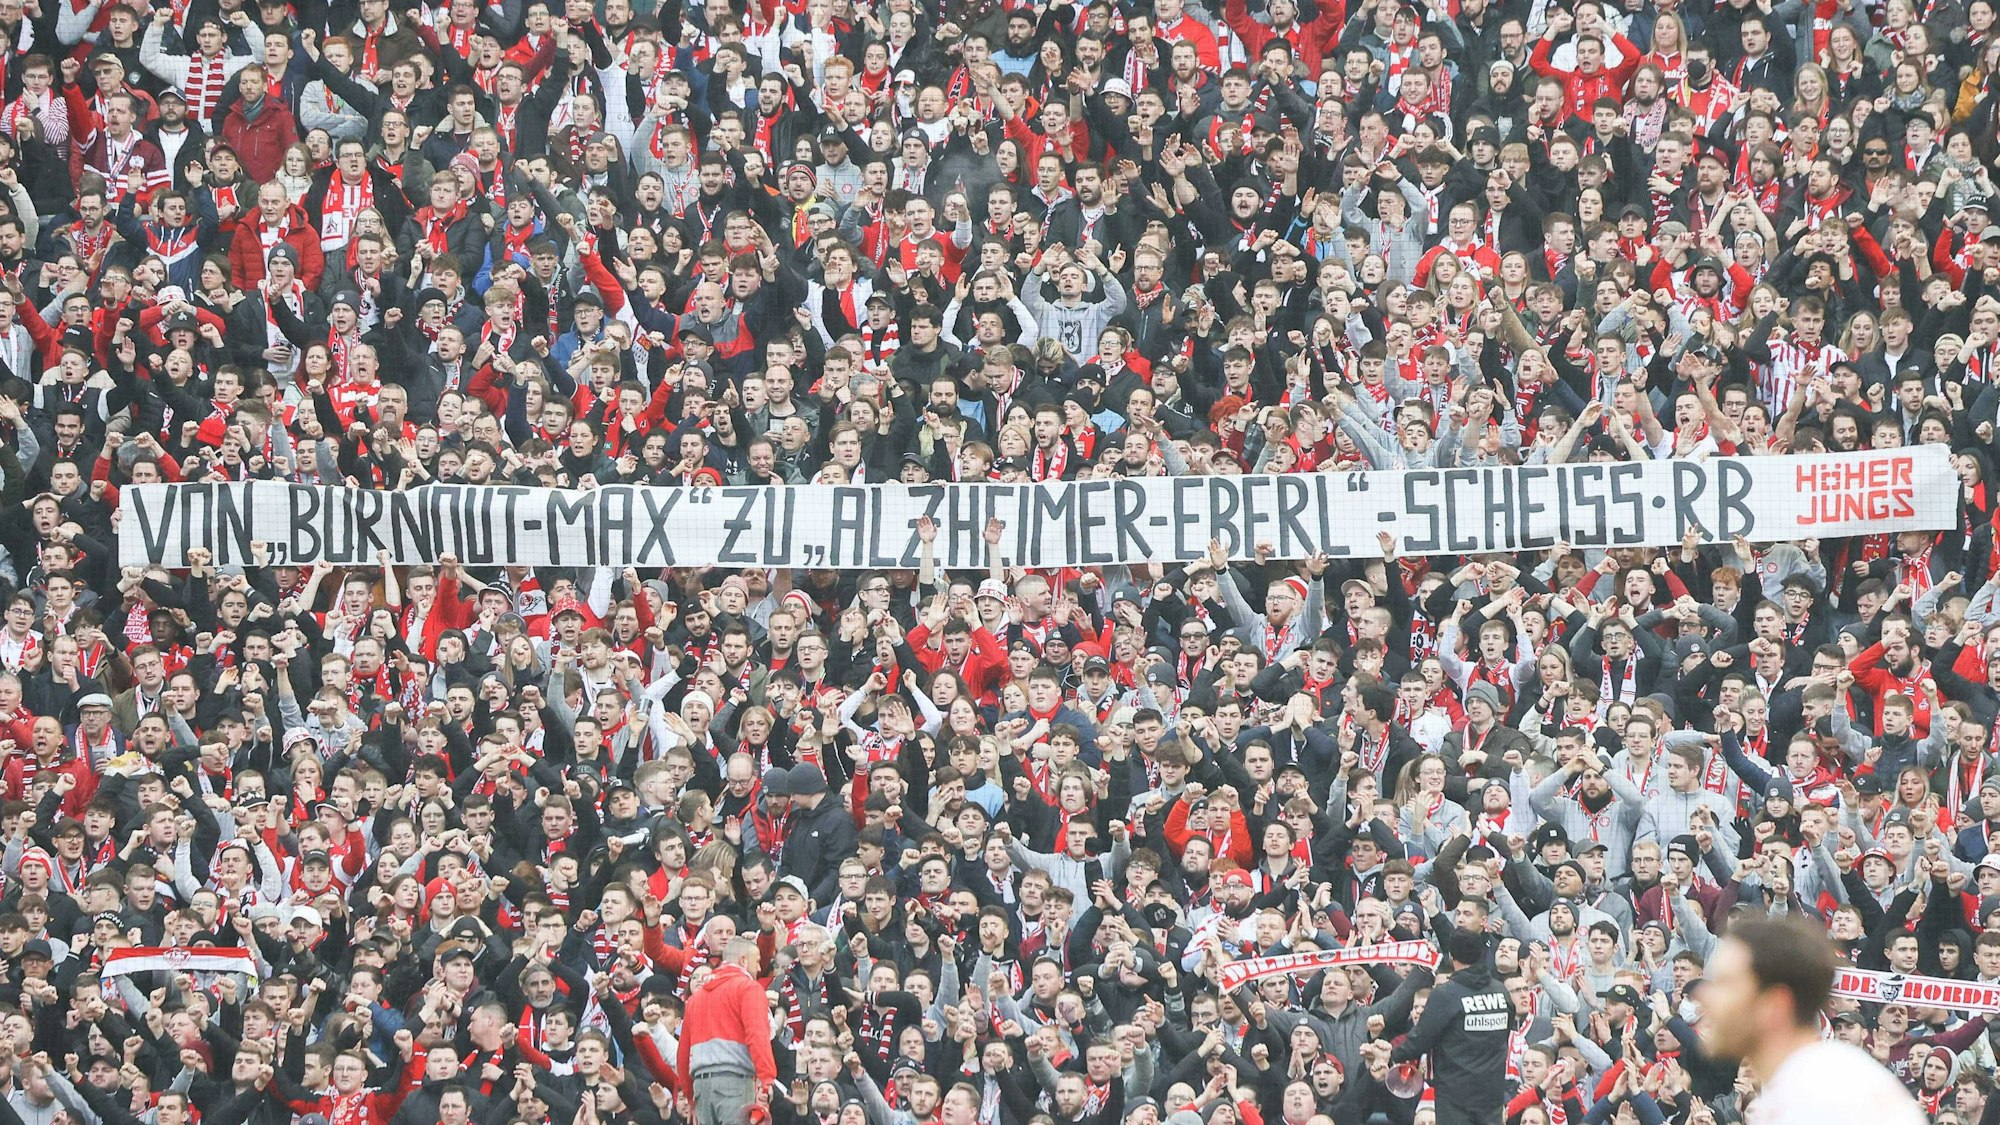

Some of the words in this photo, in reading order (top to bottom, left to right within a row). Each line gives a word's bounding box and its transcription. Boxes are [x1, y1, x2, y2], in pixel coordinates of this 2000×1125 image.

[1796, 457, 1913, 492] HÖHER
[1797, 489, 1915, 525] JUNGS
[132, 483, 252, 566] VON
[718, 487, 795, 565] ZU
[1225, 953, 1312, 982] WILDE
[1461, 993, 1507, 1013] REWE
[1904, 981, 2000, 1007] HORDE
[1466, 1015, 1507, 1028] uhlsport
